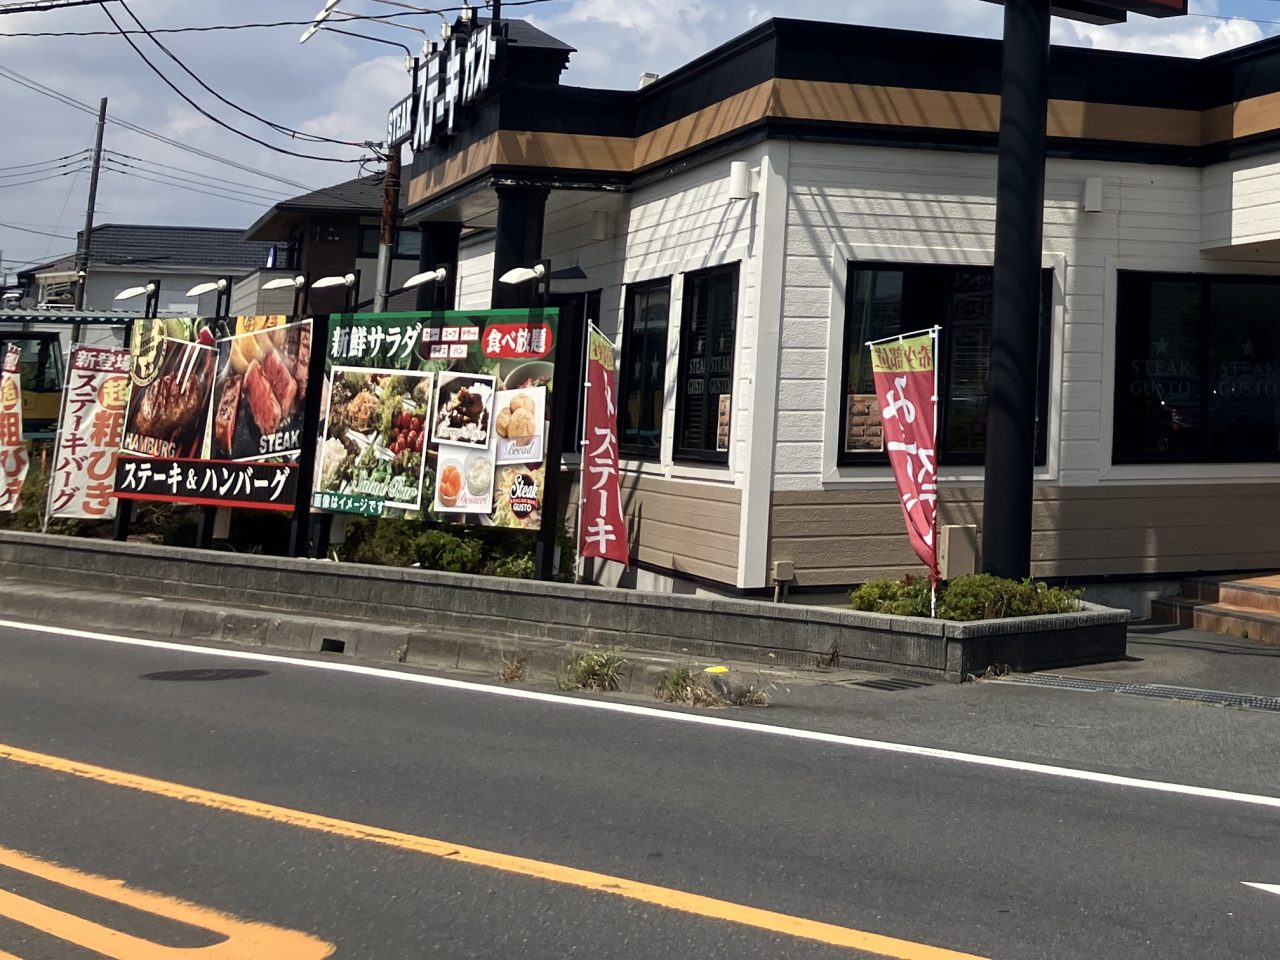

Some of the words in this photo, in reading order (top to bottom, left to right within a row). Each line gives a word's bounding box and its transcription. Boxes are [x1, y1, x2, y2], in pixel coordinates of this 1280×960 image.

[413, 39, 461, 151] ステーキ
[387, 96, 413, 146] STEAK
[330, 322, 423, 358] 新鮮サラダ
[486, 327, 547, 354] 食べ放題
[75, 350, 131, 371] 新登場
[1131, 359, 1191, 376] STEAK
[1220, 361, 1276, 377] STEAK
[1130, 379, 1190, 396] GUSTO
[1218, 380, 1277, 397] GUSTO
[124, 432, 177, 458] HAMBURG
[259, 429, 301, 454] STEAK
[504, 440, 534, 456] Bread
[510, 473, 538, 498] Steak
[585, 426, 617, 554] ステーキ
[513, 503, 532, 512] GUSTO
